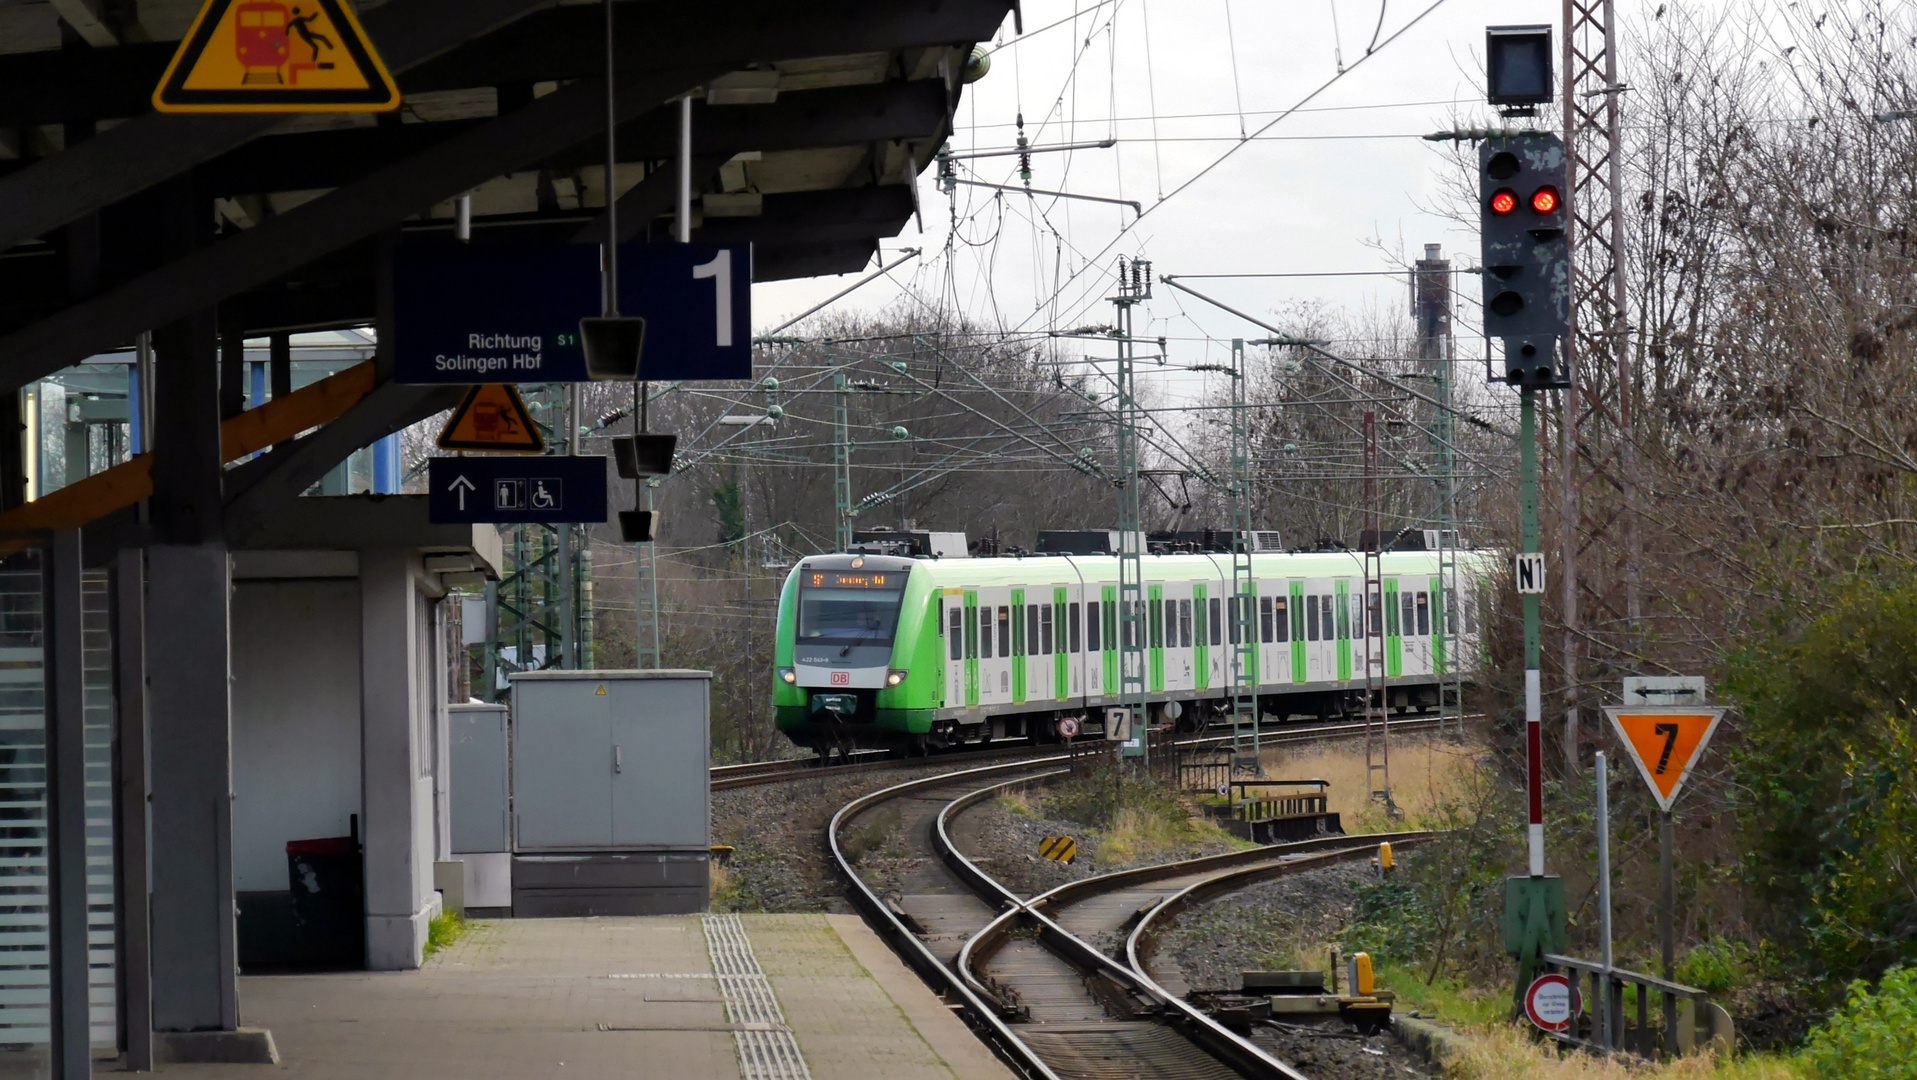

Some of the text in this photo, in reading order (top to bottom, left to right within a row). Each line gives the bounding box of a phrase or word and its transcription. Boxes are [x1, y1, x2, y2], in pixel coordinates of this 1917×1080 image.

[693, 249, 732, 347] 1
[469, 333, 541, 351] Richtung
[435, 353, 542, 373] Solingen Hbf
[1519, 558, 1542, 590] N1
[832, 673, 848, 684] DB
[1113, 712, 1124, 737] 7
[1655, 723, 1679, 775] 7
